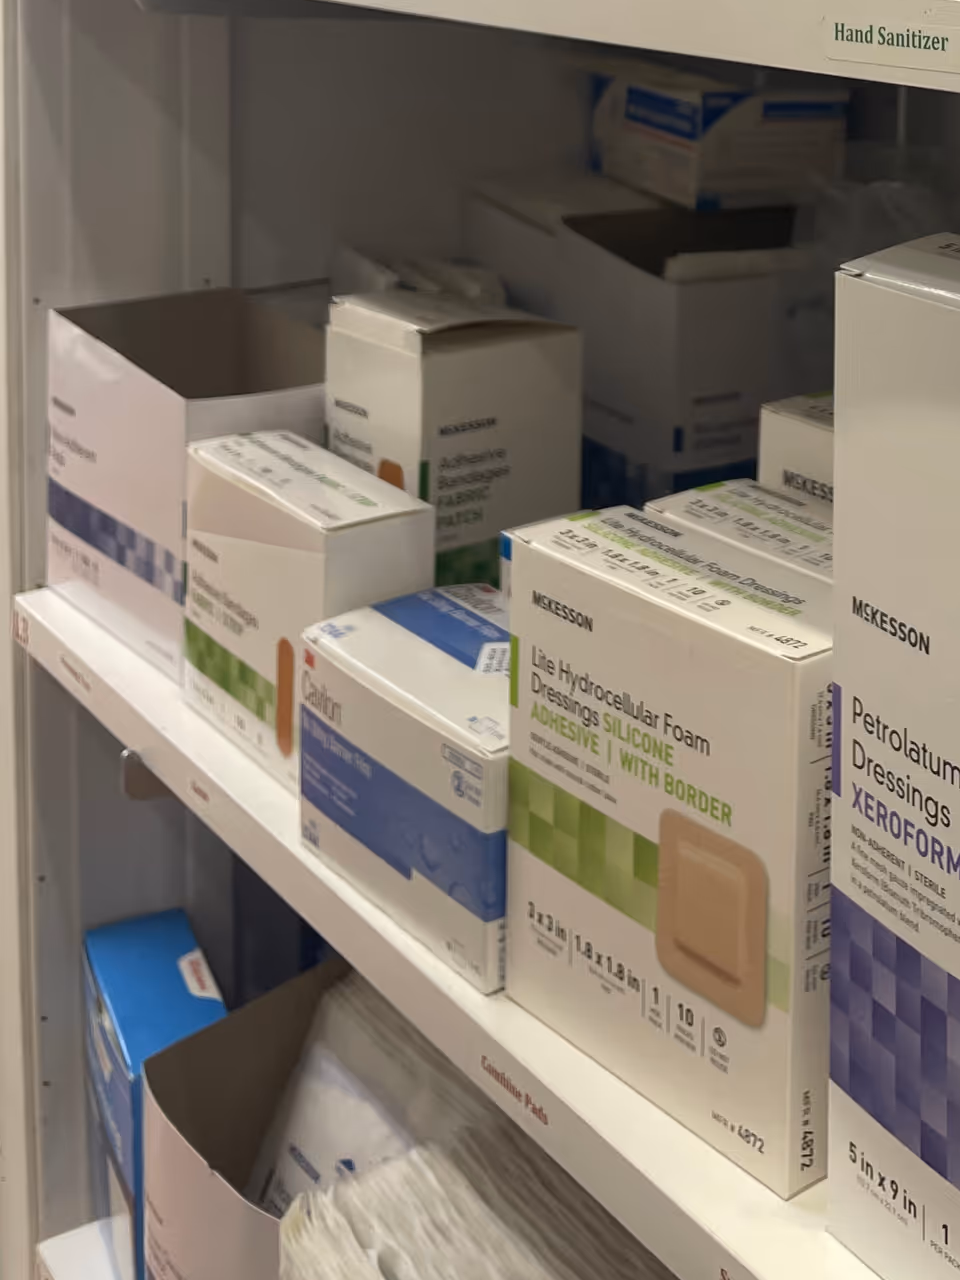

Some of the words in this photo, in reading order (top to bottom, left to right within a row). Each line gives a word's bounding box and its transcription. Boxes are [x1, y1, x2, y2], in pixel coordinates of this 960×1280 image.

[834, 22, 874, 47] Hand
[877, 25, 949, 53] Sanitizer
[704, 561, 740, 582] Foam
[738, 576, 807, 607] Dressings
[773, 634, 808, 649] 4872
[531, 645, 556, 677] Lite
[558, 658, 660, 730] Hydrocellular
[663, 712, 711, 756] Foam
[531, 671, 600, 727] Dressings
[602, 712, 675, 766] SILICONE
[530, 701, 600, 756] ADHESIVE
[619, 747, 660, 789] WITH
[664, 767, 732, 827] BORDER
[852, 737, 952, 828] Dressings
[677, 1003, 694, 1027] 10
[737, 1125, 766, 1155] 4872
[800, 1130, 814, 1172] 4872
[849, 1141, 858, 1164] 5
[860, 1152, 874, 1181] in
[878, 1171, 887, 1193] x
[890, 1179, 898, 1200] 9
[903, 1189, 917, 1219] in
[942, 1223, 949, 1246] 1
